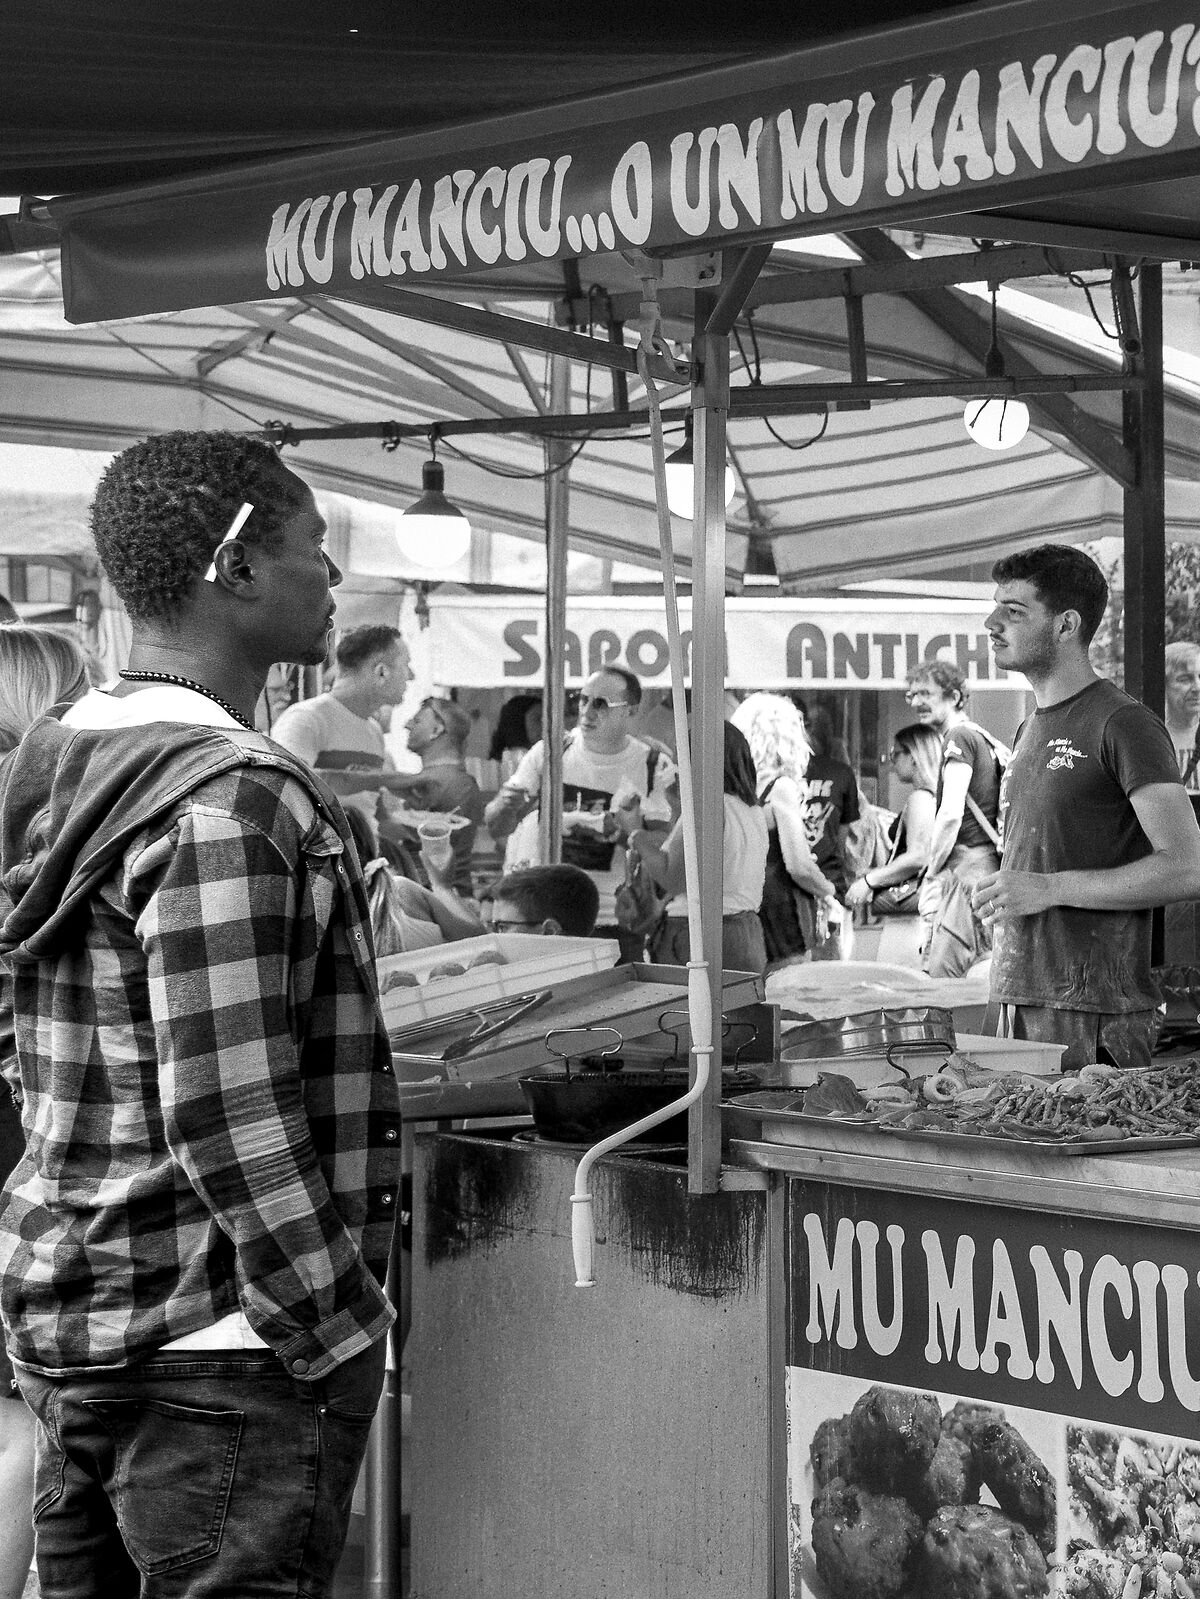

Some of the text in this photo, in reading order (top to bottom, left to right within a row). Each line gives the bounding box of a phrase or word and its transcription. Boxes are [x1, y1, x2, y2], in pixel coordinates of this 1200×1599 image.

[266, 192, 347, 290] MU
[670, 117, 763, 236] UN
[777, 91, 875, 220] MU
[787, 622, 1008, 680] ANTICH
[803, 1213, 905, 1356] MU
